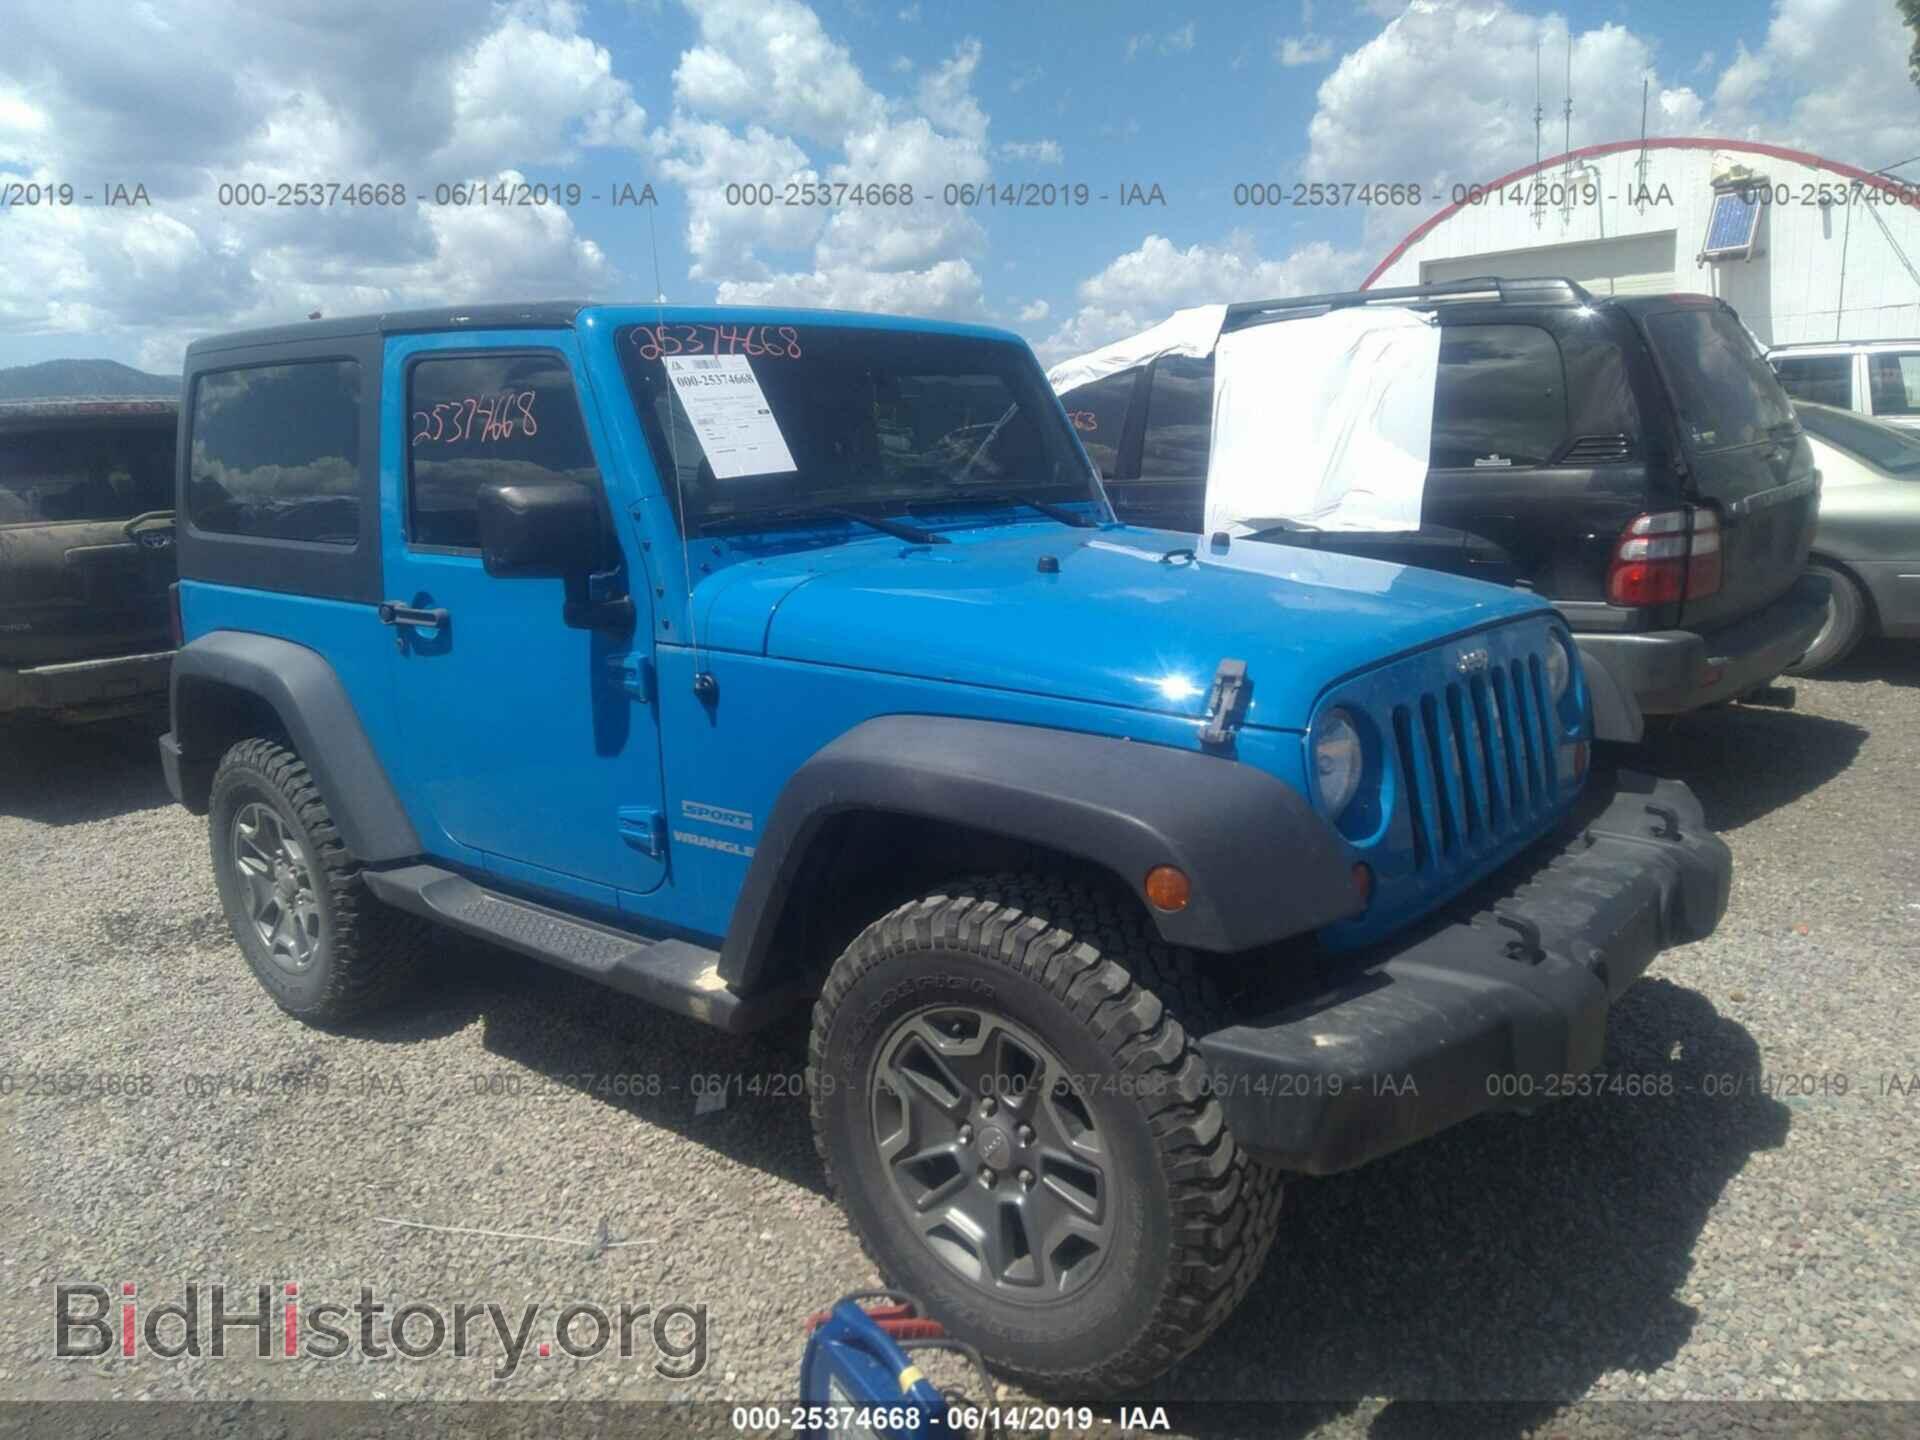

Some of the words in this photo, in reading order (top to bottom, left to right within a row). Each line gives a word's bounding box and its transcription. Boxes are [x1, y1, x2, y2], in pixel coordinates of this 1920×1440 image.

[630, 325, 801, 360] 25374668
[676, 373, 754, 388] 000-25374668
[412, 391, 537, 446] 25374668
[683, 802, 750, 828] SPORT
